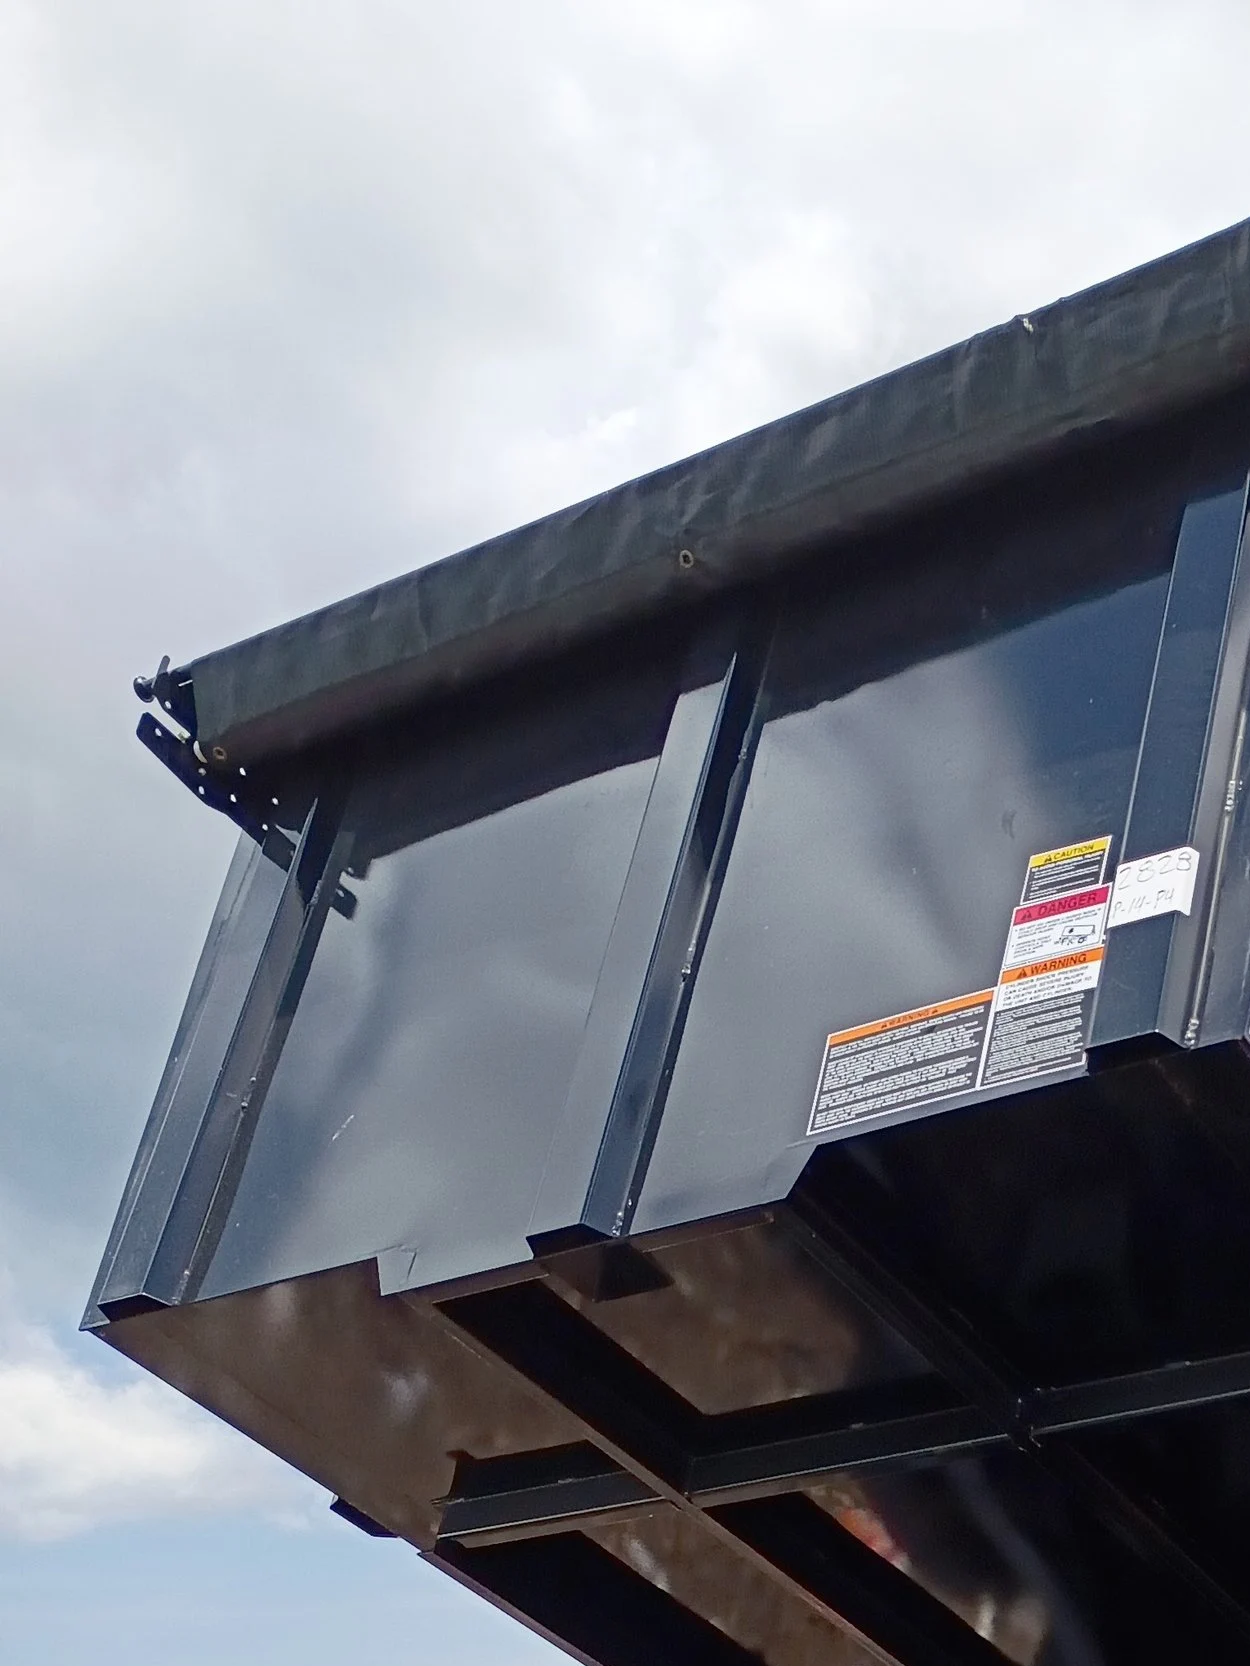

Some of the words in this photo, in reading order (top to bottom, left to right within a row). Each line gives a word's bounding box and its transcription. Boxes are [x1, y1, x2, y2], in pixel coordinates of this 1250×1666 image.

[1052, 844, 1095, 861] CAUTION
[1116, 850, 1193, 891] 2828
[1037, 892, 1099, 917] DANGER
[1030, 953, 1087, 974] WARNING
